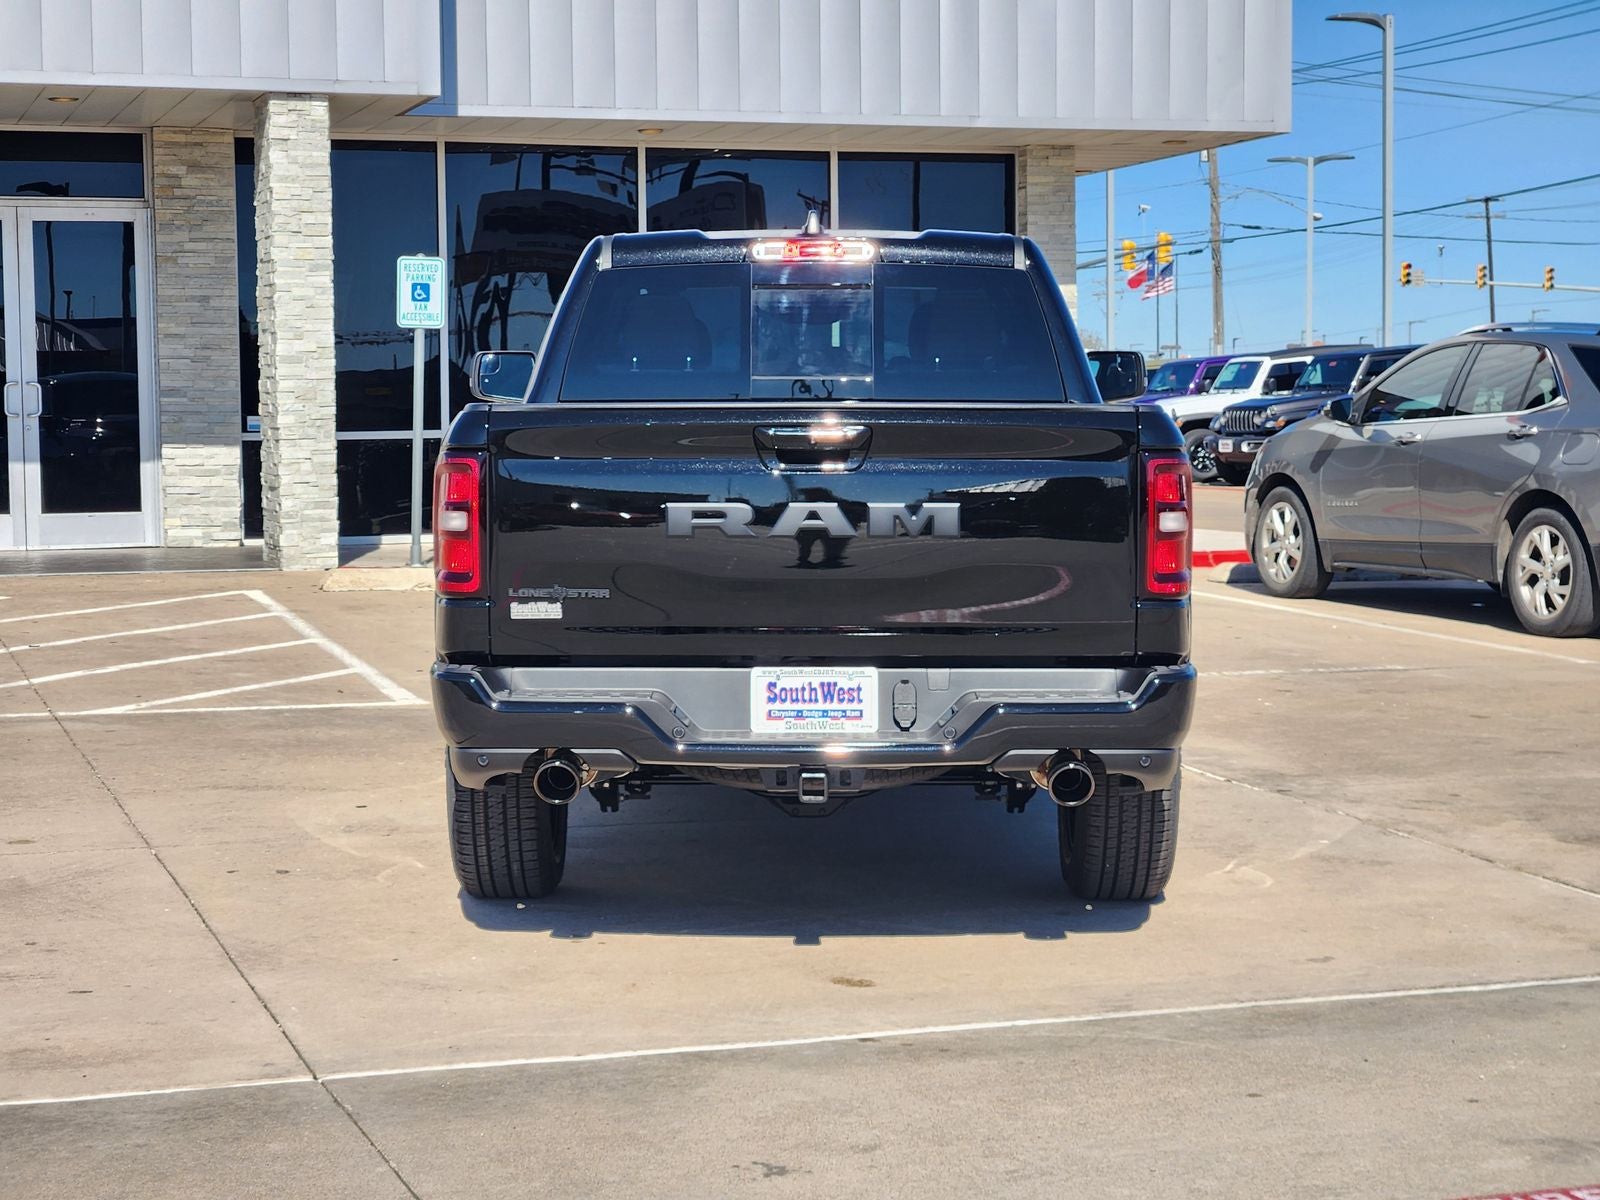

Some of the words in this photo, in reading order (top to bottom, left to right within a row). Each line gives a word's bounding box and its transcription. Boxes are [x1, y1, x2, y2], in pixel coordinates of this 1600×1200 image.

[404, 263, 439, 273] RESERVED
[406, 273, 436, 282] PARKING
[414, 303, 428, 311] VAN
[402, 312, 440, 321] ACCESSIBLE
[665, 502, 961, 538] RAM
[508, 587, 551, 597] LONE
[566, 588, 610, 598] STAR
[766, 681, 864, 704] SouthWest
[770, 710, 798, 718] Chrysler
[802, 710, 823, 718] Dodge
[827, 710, 843, 718] Jeep
[784, 720, 846, 730] SouthWest
